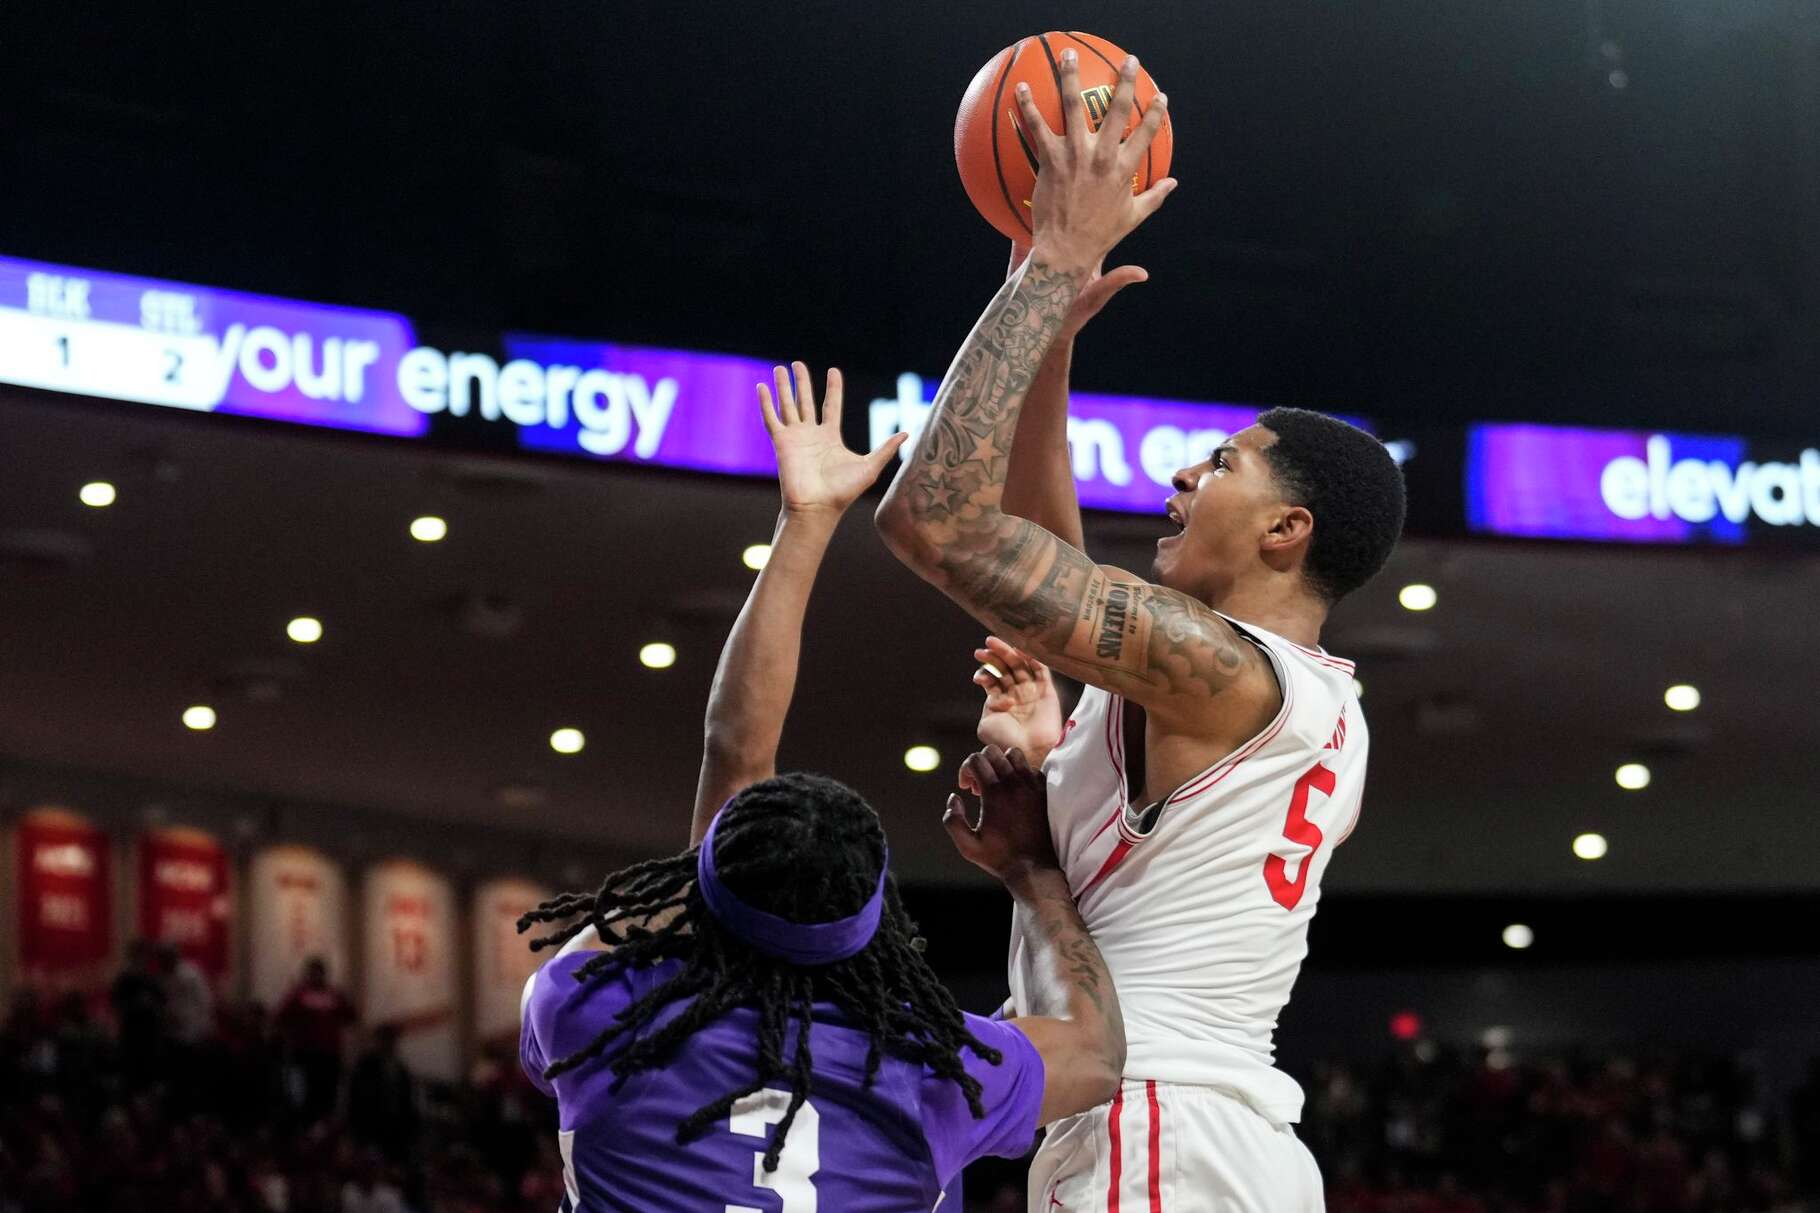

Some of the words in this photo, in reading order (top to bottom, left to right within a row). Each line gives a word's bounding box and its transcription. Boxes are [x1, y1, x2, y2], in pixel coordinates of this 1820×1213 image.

[56, 335, 70, 368] 1
[161, 347, 185, 383] 2
[397, 346, 678, 459] energy
[1263, 760, 1336, 911] 5
[725, 1087, 819, 1213] 3
